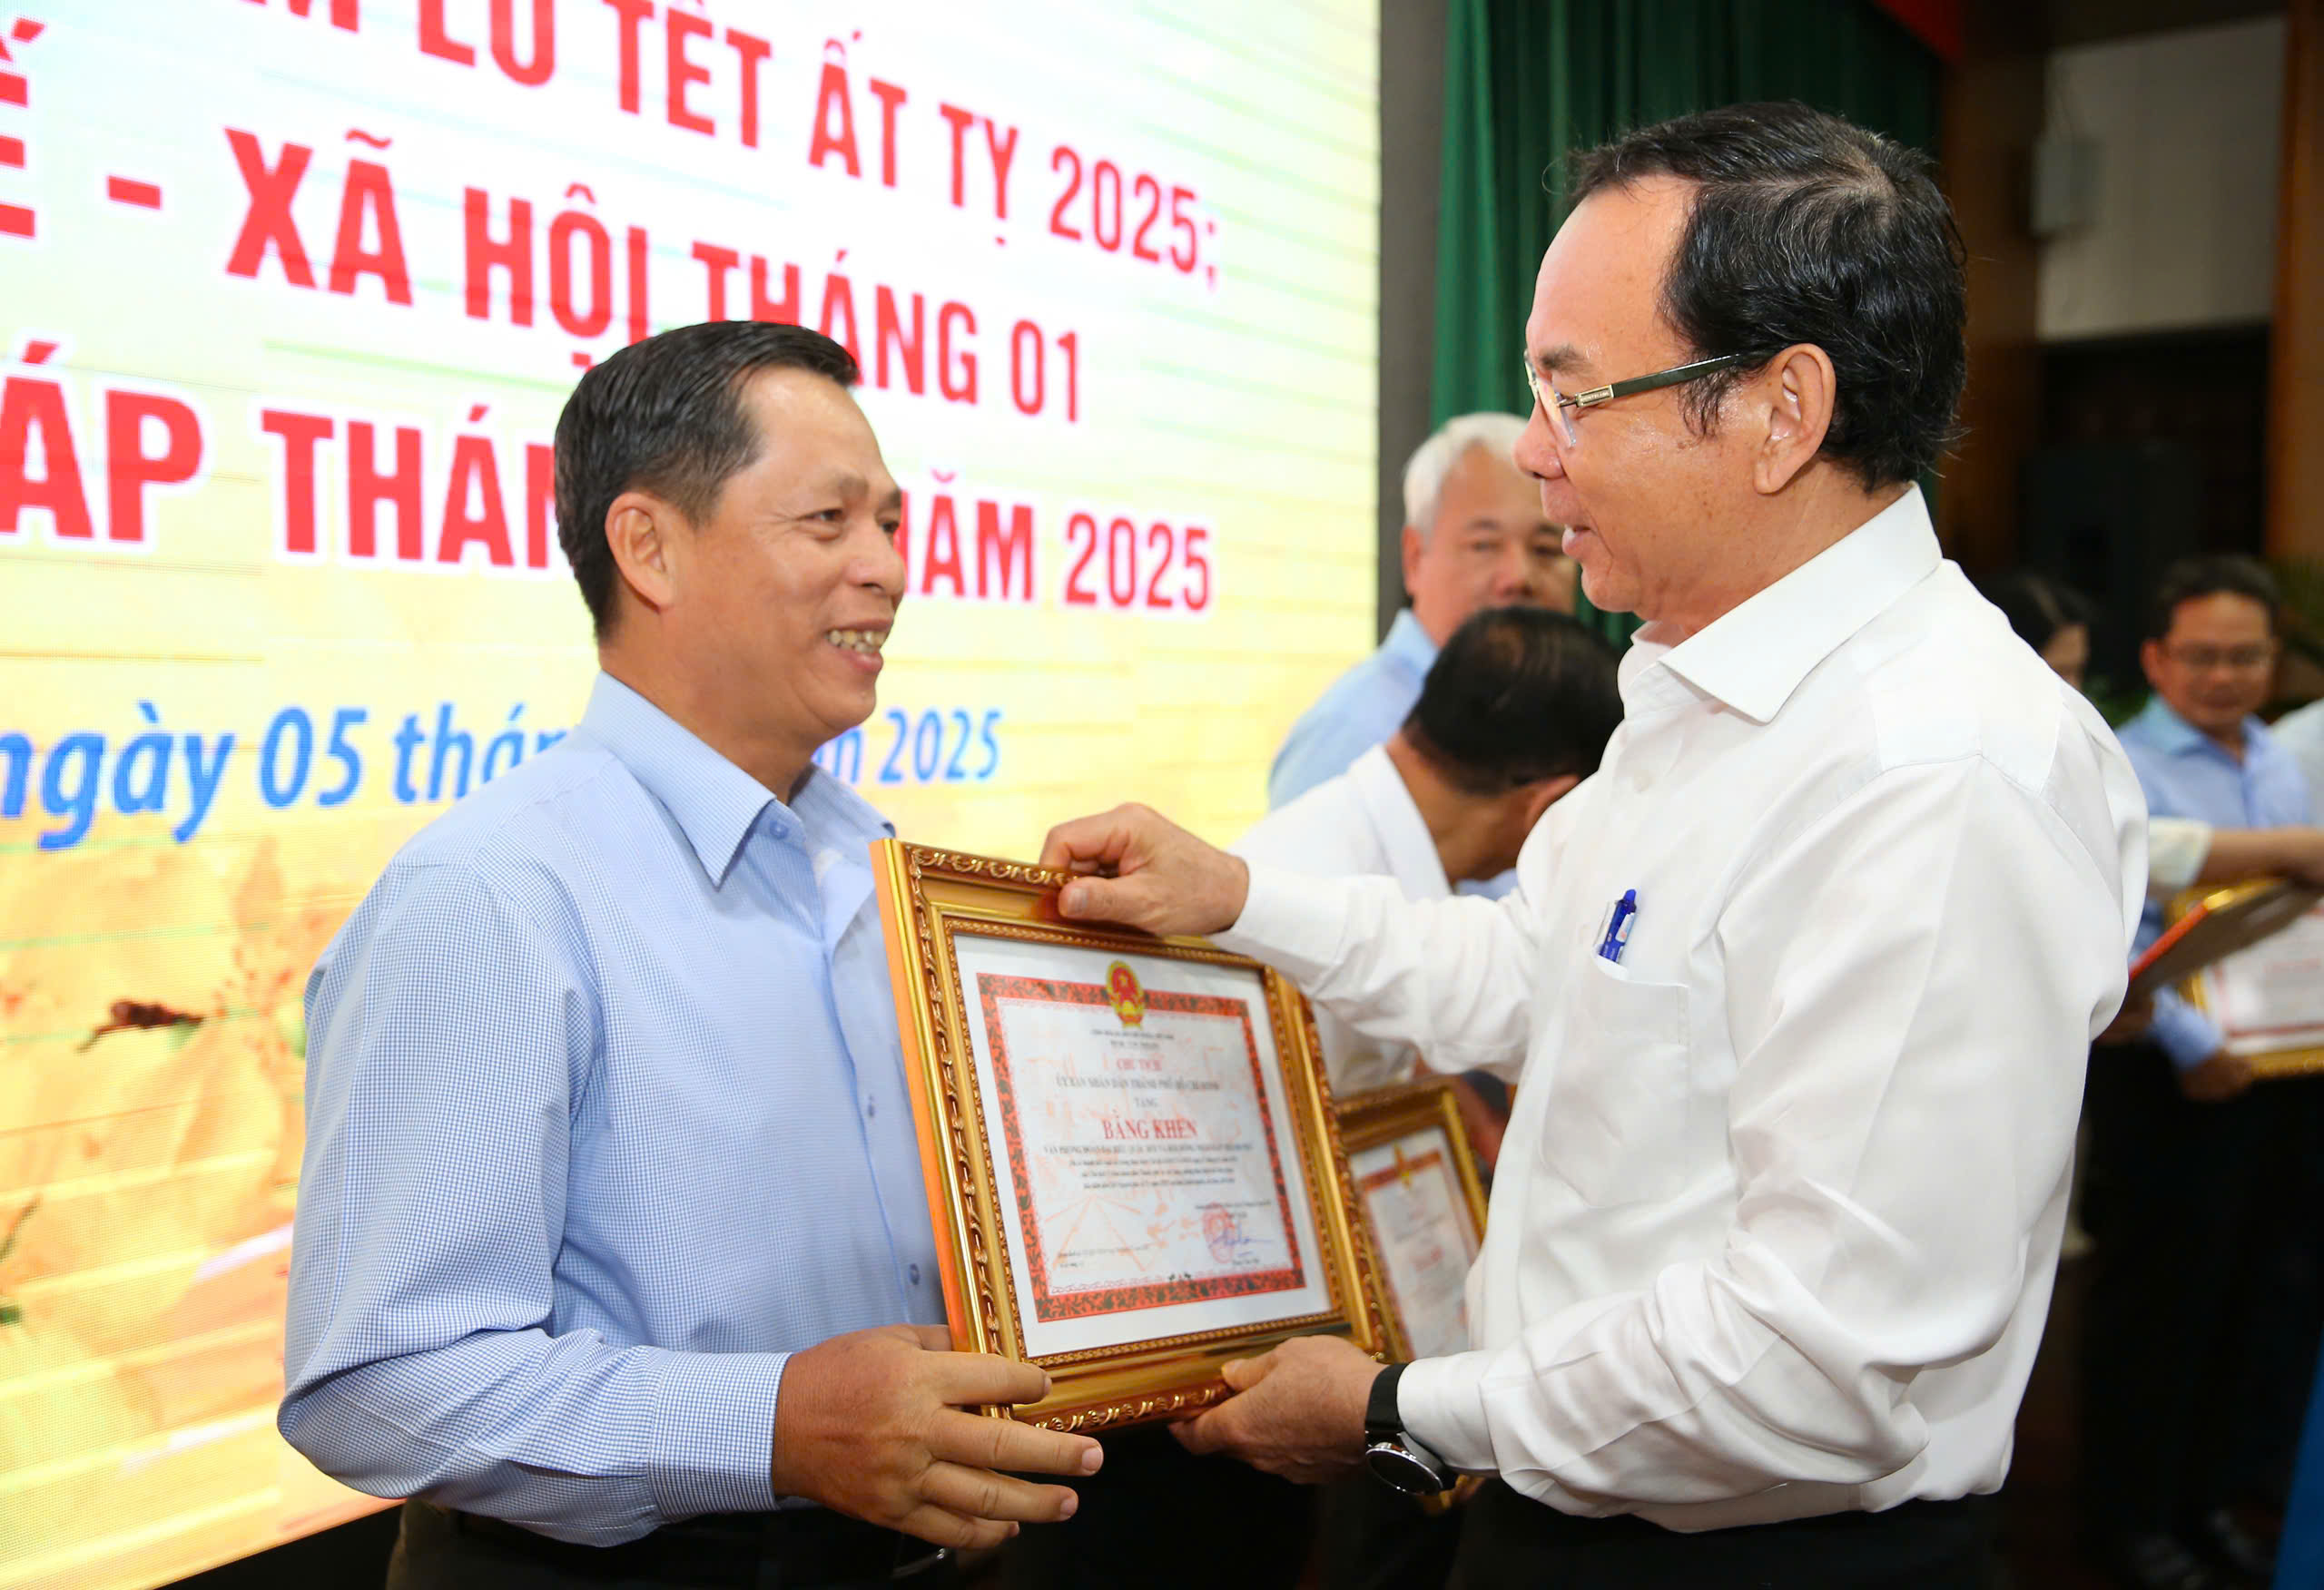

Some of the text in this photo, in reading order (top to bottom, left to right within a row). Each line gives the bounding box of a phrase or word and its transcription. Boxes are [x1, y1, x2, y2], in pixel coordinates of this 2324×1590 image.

[808, 31, 908, 189] ẤT
[939, 102, 1019, 245] TỴ
[1049, 144, 1216, 290] 2025;
[224, 127, 413, 309] XÃ
[463, 182, 651, 373] HỘI
[691, 250, 978, 406] THÁNG
[1010, 319, 1078, 424] 01
[891, 468, 1034, 602] ĂM
[1065, 512, 1209, 613] 2025
[261, 706, 369, 809] 05
[393, 702, 569, 805] thá
[878, 709, 1001, 784] 2025
[1151, 1118, 1198, 1140] KHEN
